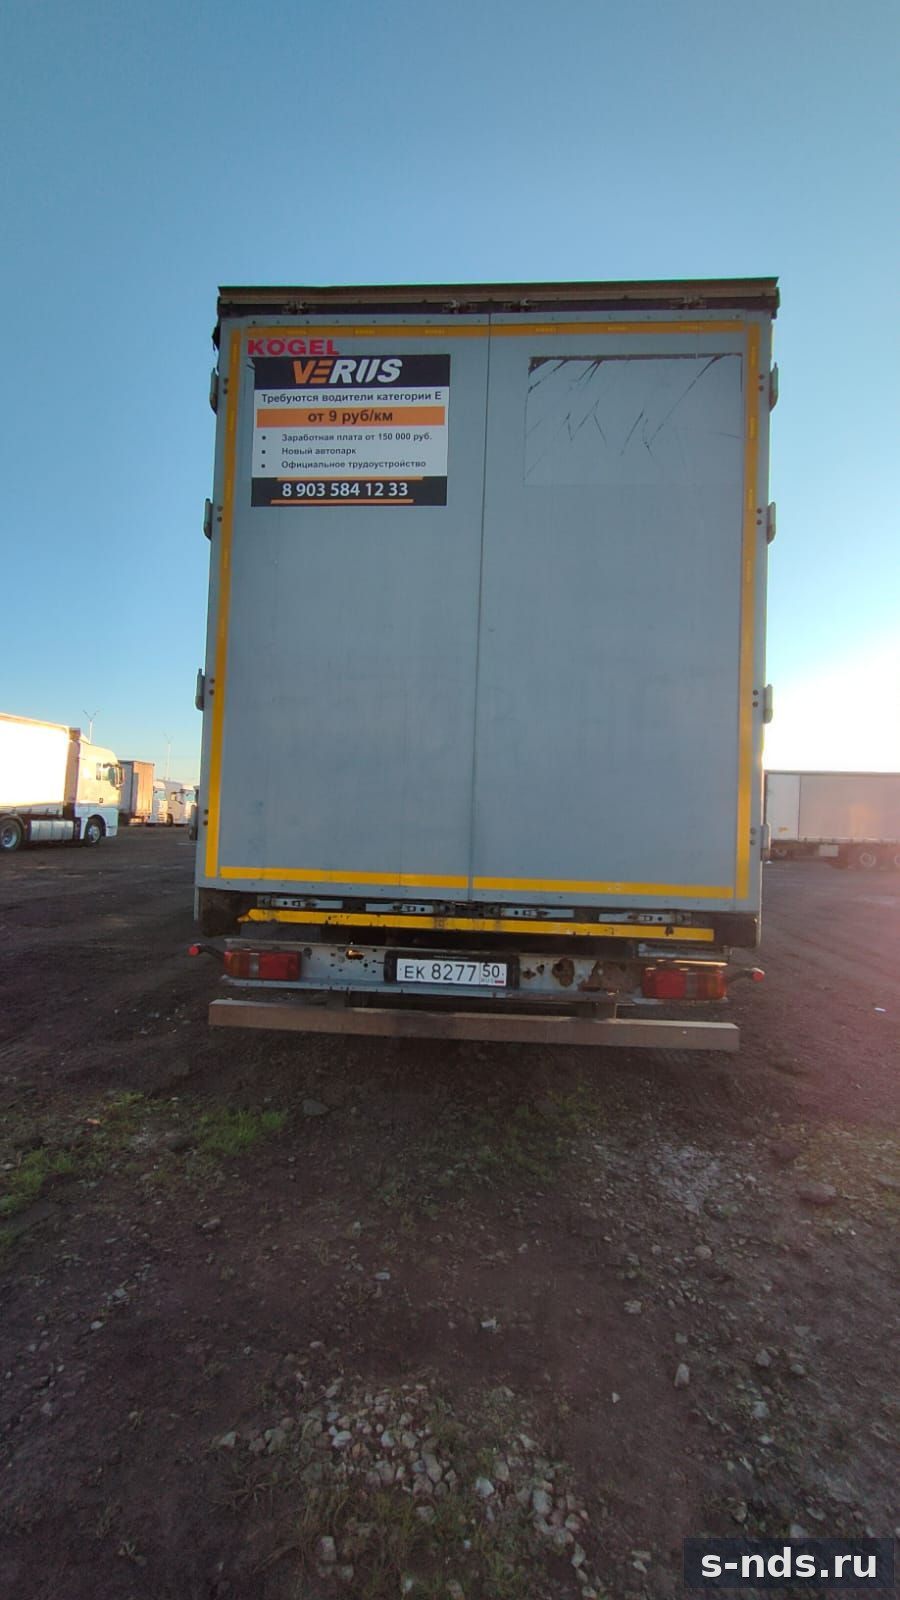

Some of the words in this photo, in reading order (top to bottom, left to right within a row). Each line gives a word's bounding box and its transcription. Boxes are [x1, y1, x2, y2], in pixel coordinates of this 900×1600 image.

[262, 393, 319, 405] Требуются
[322, 392, 374, 403] водители
[376, 391, 432, 403] категории
[308, 412, 324, 422] от
[328, 410, 337, 422] 9
[342, 409, 393, 426] руб/км
[281, 433, 334, 442] Заработная
[378, 433, 393, 441] 150
[395, 432, 411, 440] 000
[413, 432, 432, 442] руб.
[281, 447, 313, 455] Новый
[315, 448, 357, 456] автопарк
[281, 461, 345, 470] Официальное
[348, 460, 426, 469] трудоустройство
[282, 483, 292, 497] 8
[296, 483, 325, 497] 903
[330, 482, 360, 497] 584
[365, 482, 384, 496] 12
[388, 482, 408, 496] 33
[431, 963, 477, 982] 8277
[482, 964, 500, 978] 50
